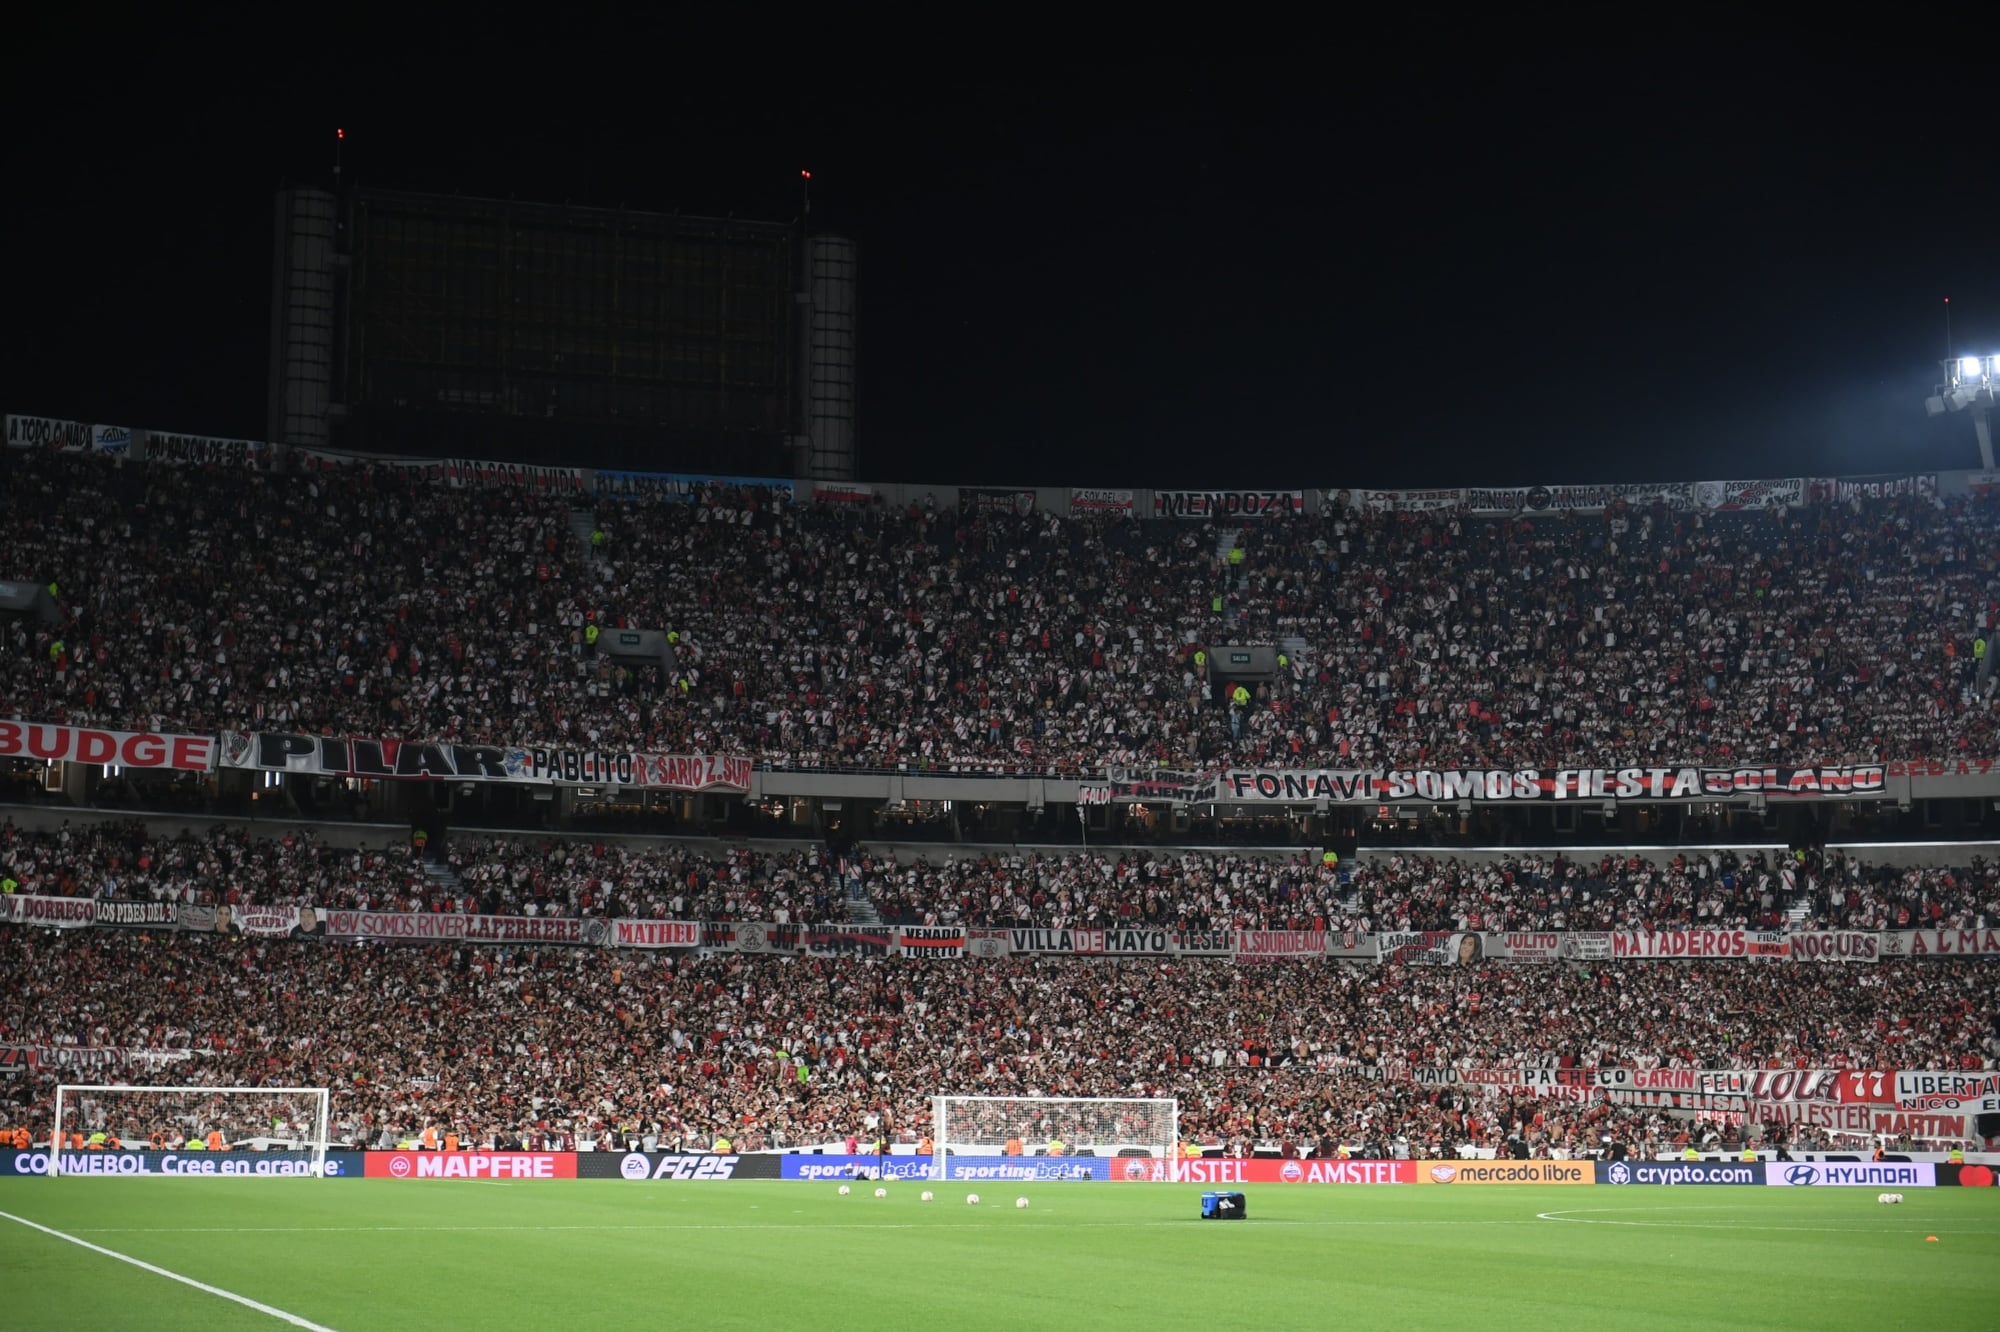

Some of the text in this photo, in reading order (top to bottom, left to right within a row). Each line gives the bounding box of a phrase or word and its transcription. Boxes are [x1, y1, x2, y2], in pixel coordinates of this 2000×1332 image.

[21, 420, 50, 443] TODO
[453, 459, 482, 486] VOS
[1725, 482, 1756, 493] DESDE
[1161, 492, 1295, 516] MENDOZA
[1232, 654, 1249, 662] SALIDA
[0, 721, 209, 771] BUDGE
[258, 733, 508, 778] PILAR
[533, 749, 632, 783] PABLITO
[1233, 771, 1374, 800] FONAVI
[1388, 770, 1541, 800] SOMOS
[1555, 768, 1702, 800] FIESTA
[1705, 766, 1884, 794] SOLANO
[24, 898, 94, 921] DORREGO
[96, 902, 115, 920] LOS
[116, 903, 146, 924] PIBES
[362, 914, 415, 936] SOMOS
[418, 915, 465, 938] RIVER
[465, 916, 582, 941] LAFERRERE
[617, 921, 697, 943] MATHEU
[905, 928, 961, 940] VENADO
[1012, 929, 1166, 952] VILLA DE MAYO
[1177, 929, 1230, 951] TESEI
[1239, 931, 1327, 953] A.SOURDEAUX
[1379, 933, 1450, 951] LADRON DE
[1504, 934, 1558, 949] JULITO
[1612, 931, 1745, 957] MATADEROS
[1791, 933, 1877, 958] NOGUES
[906, 945, 958, 958] TUERTO
[1412, 1068, 1457, 1084] MAYO
[1525, 1070, 1626, 1085] PACHECO
[1634, 1070, 1695, 1089] GARIN
[1700, 1073, 1746, 1093] FELI
[1849, 1071, 1886, 1098] 77
[1899, 1075, 2000, 1097] LIBERTA
[1679, 1093, 1746, 1111] ELISA
[1902, 1098, 2000, 1111] NICO E
[1875, 1114, 1964, 1137] MARTIN
[14, 1153, 338, 1175] CONMEBOL Cree en grane
[416, 1156, 554, 1178] MAPFRE
[627, 1159, 644, 1170] EA
[955, 1161, 1092, 1181] sportingbet.tv
[1151, 1161, 1248, 1182] AMSTEL
[1307, 1162, 1403, 1183] AMSTEL
[1460, 1164, 1582, 1182] mercado libre
[1636, 1164, 1753, 1185] crypto.com
[1826, 1167, 1918, 1184] HYUNDAI
